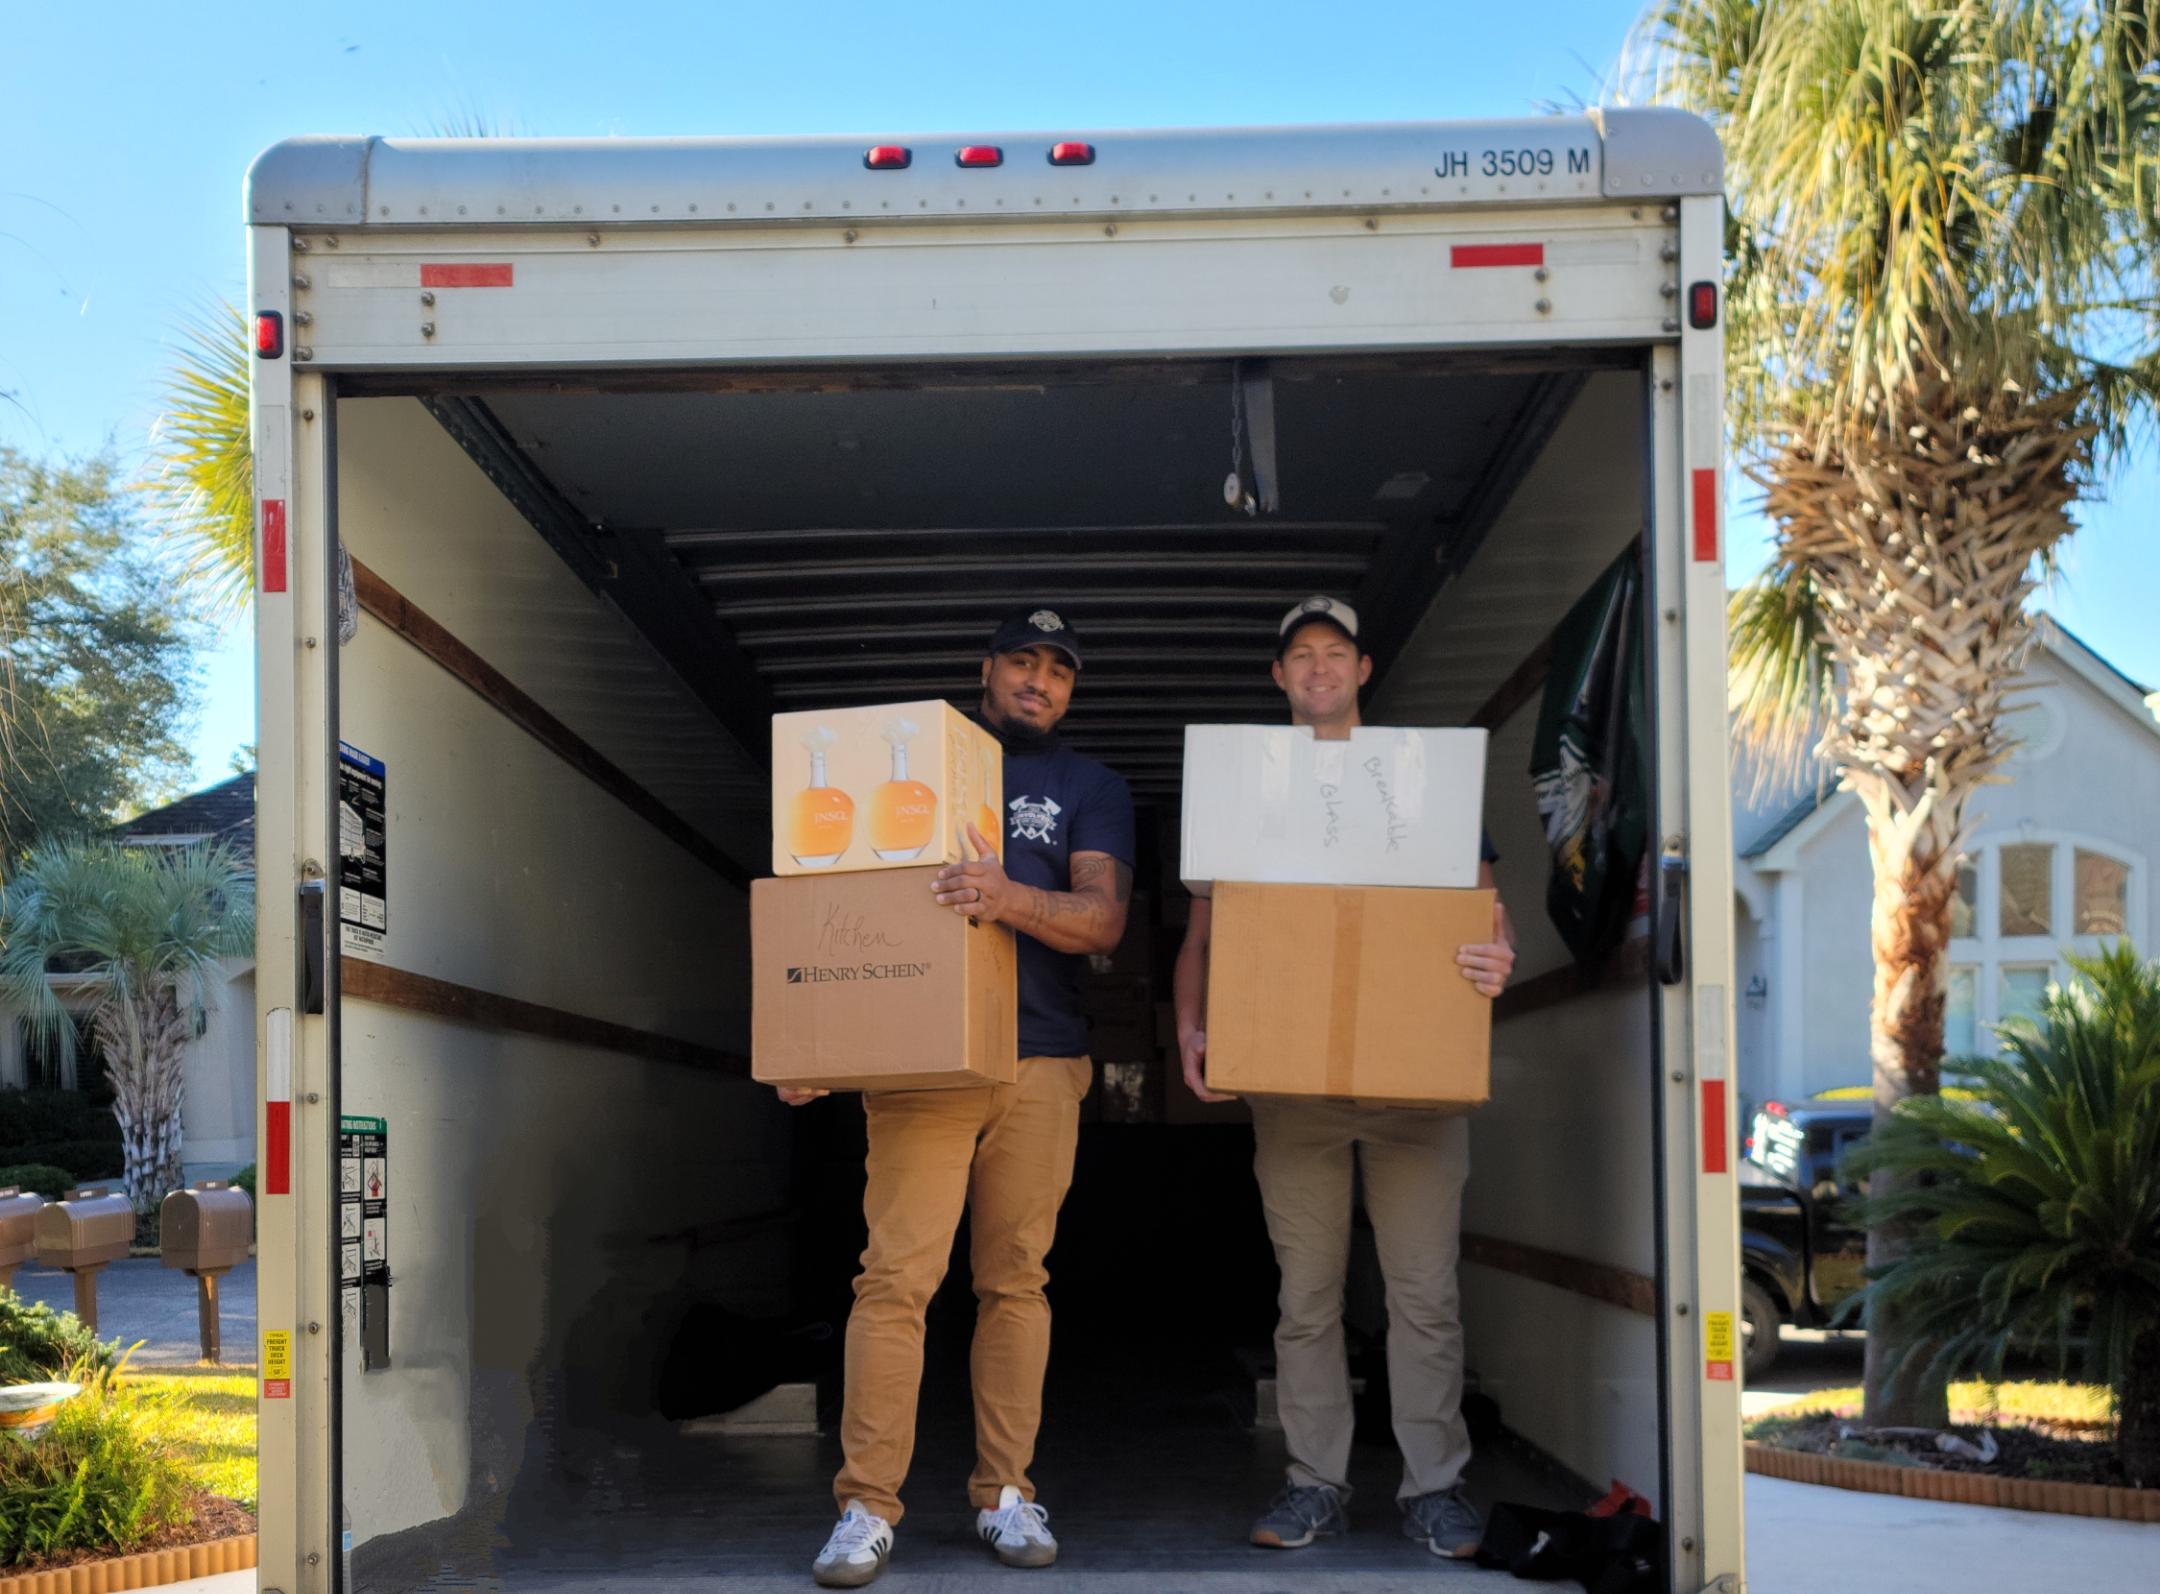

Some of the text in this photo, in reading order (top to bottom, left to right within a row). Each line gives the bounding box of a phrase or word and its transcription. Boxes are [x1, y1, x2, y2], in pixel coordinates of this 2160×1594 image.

[1434, 147, 1590, 178] JH 3509 M
[814, 810, 848, 825] JNSQ
[896, 804, 930, 818] JNSQ
[1362, 756, 1408, 855] Breakable
[818, 902, 904, 957] Kitchen
[803, 966, 861, 983] HENRY
